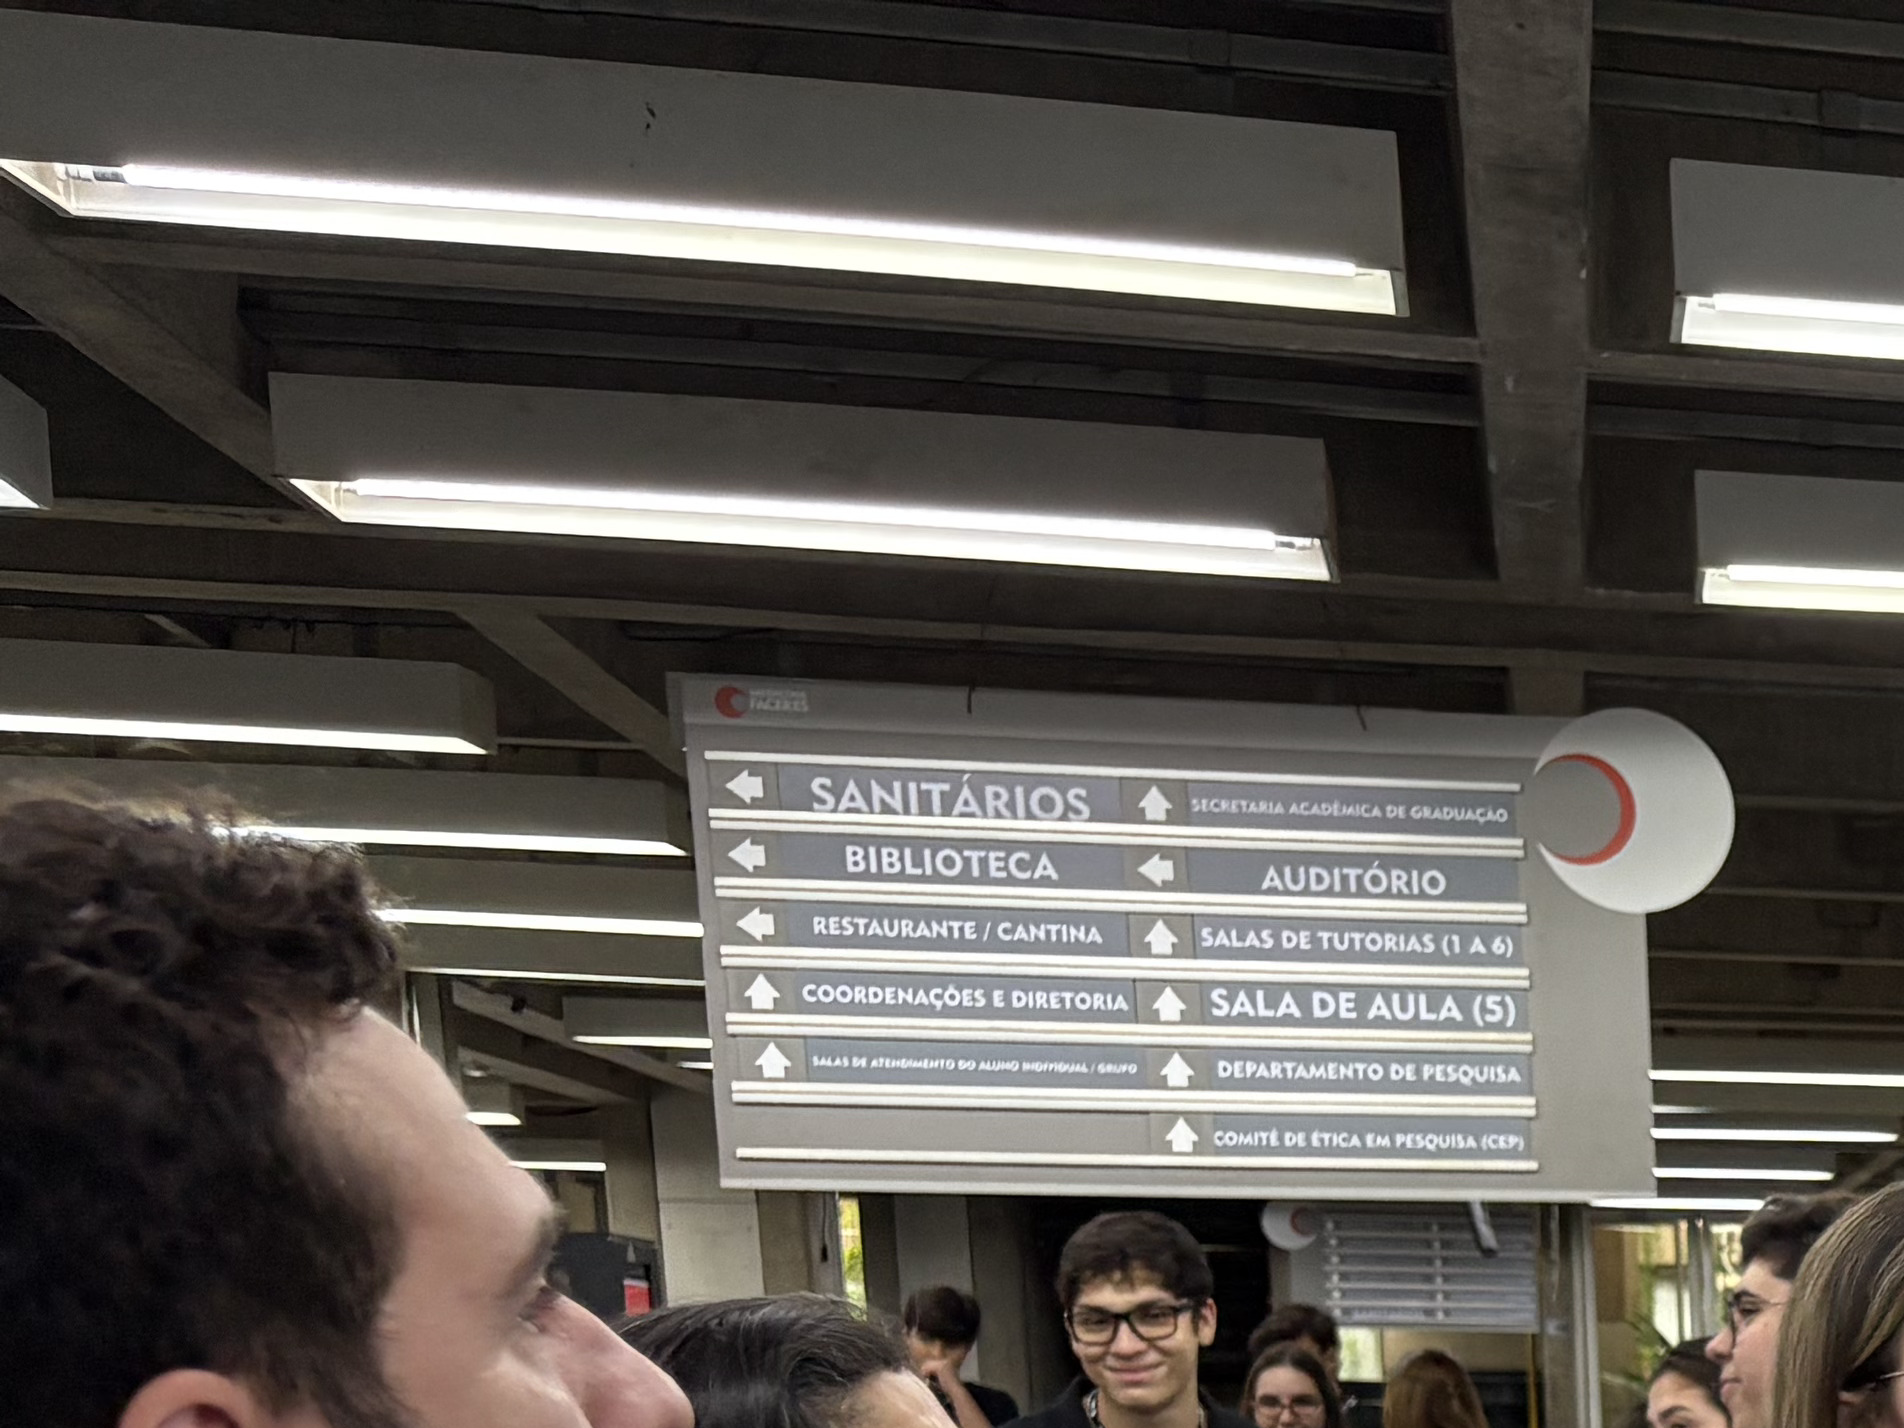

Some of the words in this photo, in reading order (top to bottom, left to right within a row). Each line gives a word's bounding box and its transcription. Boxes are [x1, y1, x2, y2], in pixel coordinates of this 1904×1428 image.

[810, 773, 1090, 821] SANITÁRIOS
[1191, 798, 1285, 815] SECRETARIA
[1288, 800, 1383, 818] ACADÊMICA
[1385, 804, 1407, 819] DE
[1409, 805, 1509, 825] GRADUAÇÃO
[845, 845, 1059, 881] BIBLIOTECA
[1261, 860, 1446, 896] AUDITÓRIO
[813, 916, 978, 940] RESTAURANTE
[982, 921, 992, 942] /
[996, 921, 1103, 944] CANTINA
[1200, 927, 1275, 950] SALAS
[1281, 929, 1312, 950] DE
[1316, 930, 1436, 954] TUTORIAS
[1441, 934, 1461, 957] (1
[1468, 935, 1487, 954] A
[1491, 935, 1514, 958] 6)
[801, 983, 987, 1011] COORDENAÇÕES
[992, 989, 1005, 1008] E
[1011, 989, 1129, 1012] DIRETORIA
[1210, 987, 1302, 1018] SALA
[1311, 990, 1358, 1019] DE
[1366, 992, 1463, 1022] AULA
[1472, 994, 1516, 1028] (5)
[1217, 1059, 1384, 1081] DEPARTAMENTO
[1389, 1062, 1417, 1082] DE
[1422, 1063, 1522, 1086] PESQUISA
[1213, 1127, 1280, 1147] COMITÊ
[1283, 1131, 1307, 1148] DE
[1310, 1129, 1362, 1148] ÉTICA
[1365, 1132, 1391, 1148] EM
[1395, 1132, 1478, 1152] PESQUISA
[1480, 1134, 1525, 1151] (CEP)
